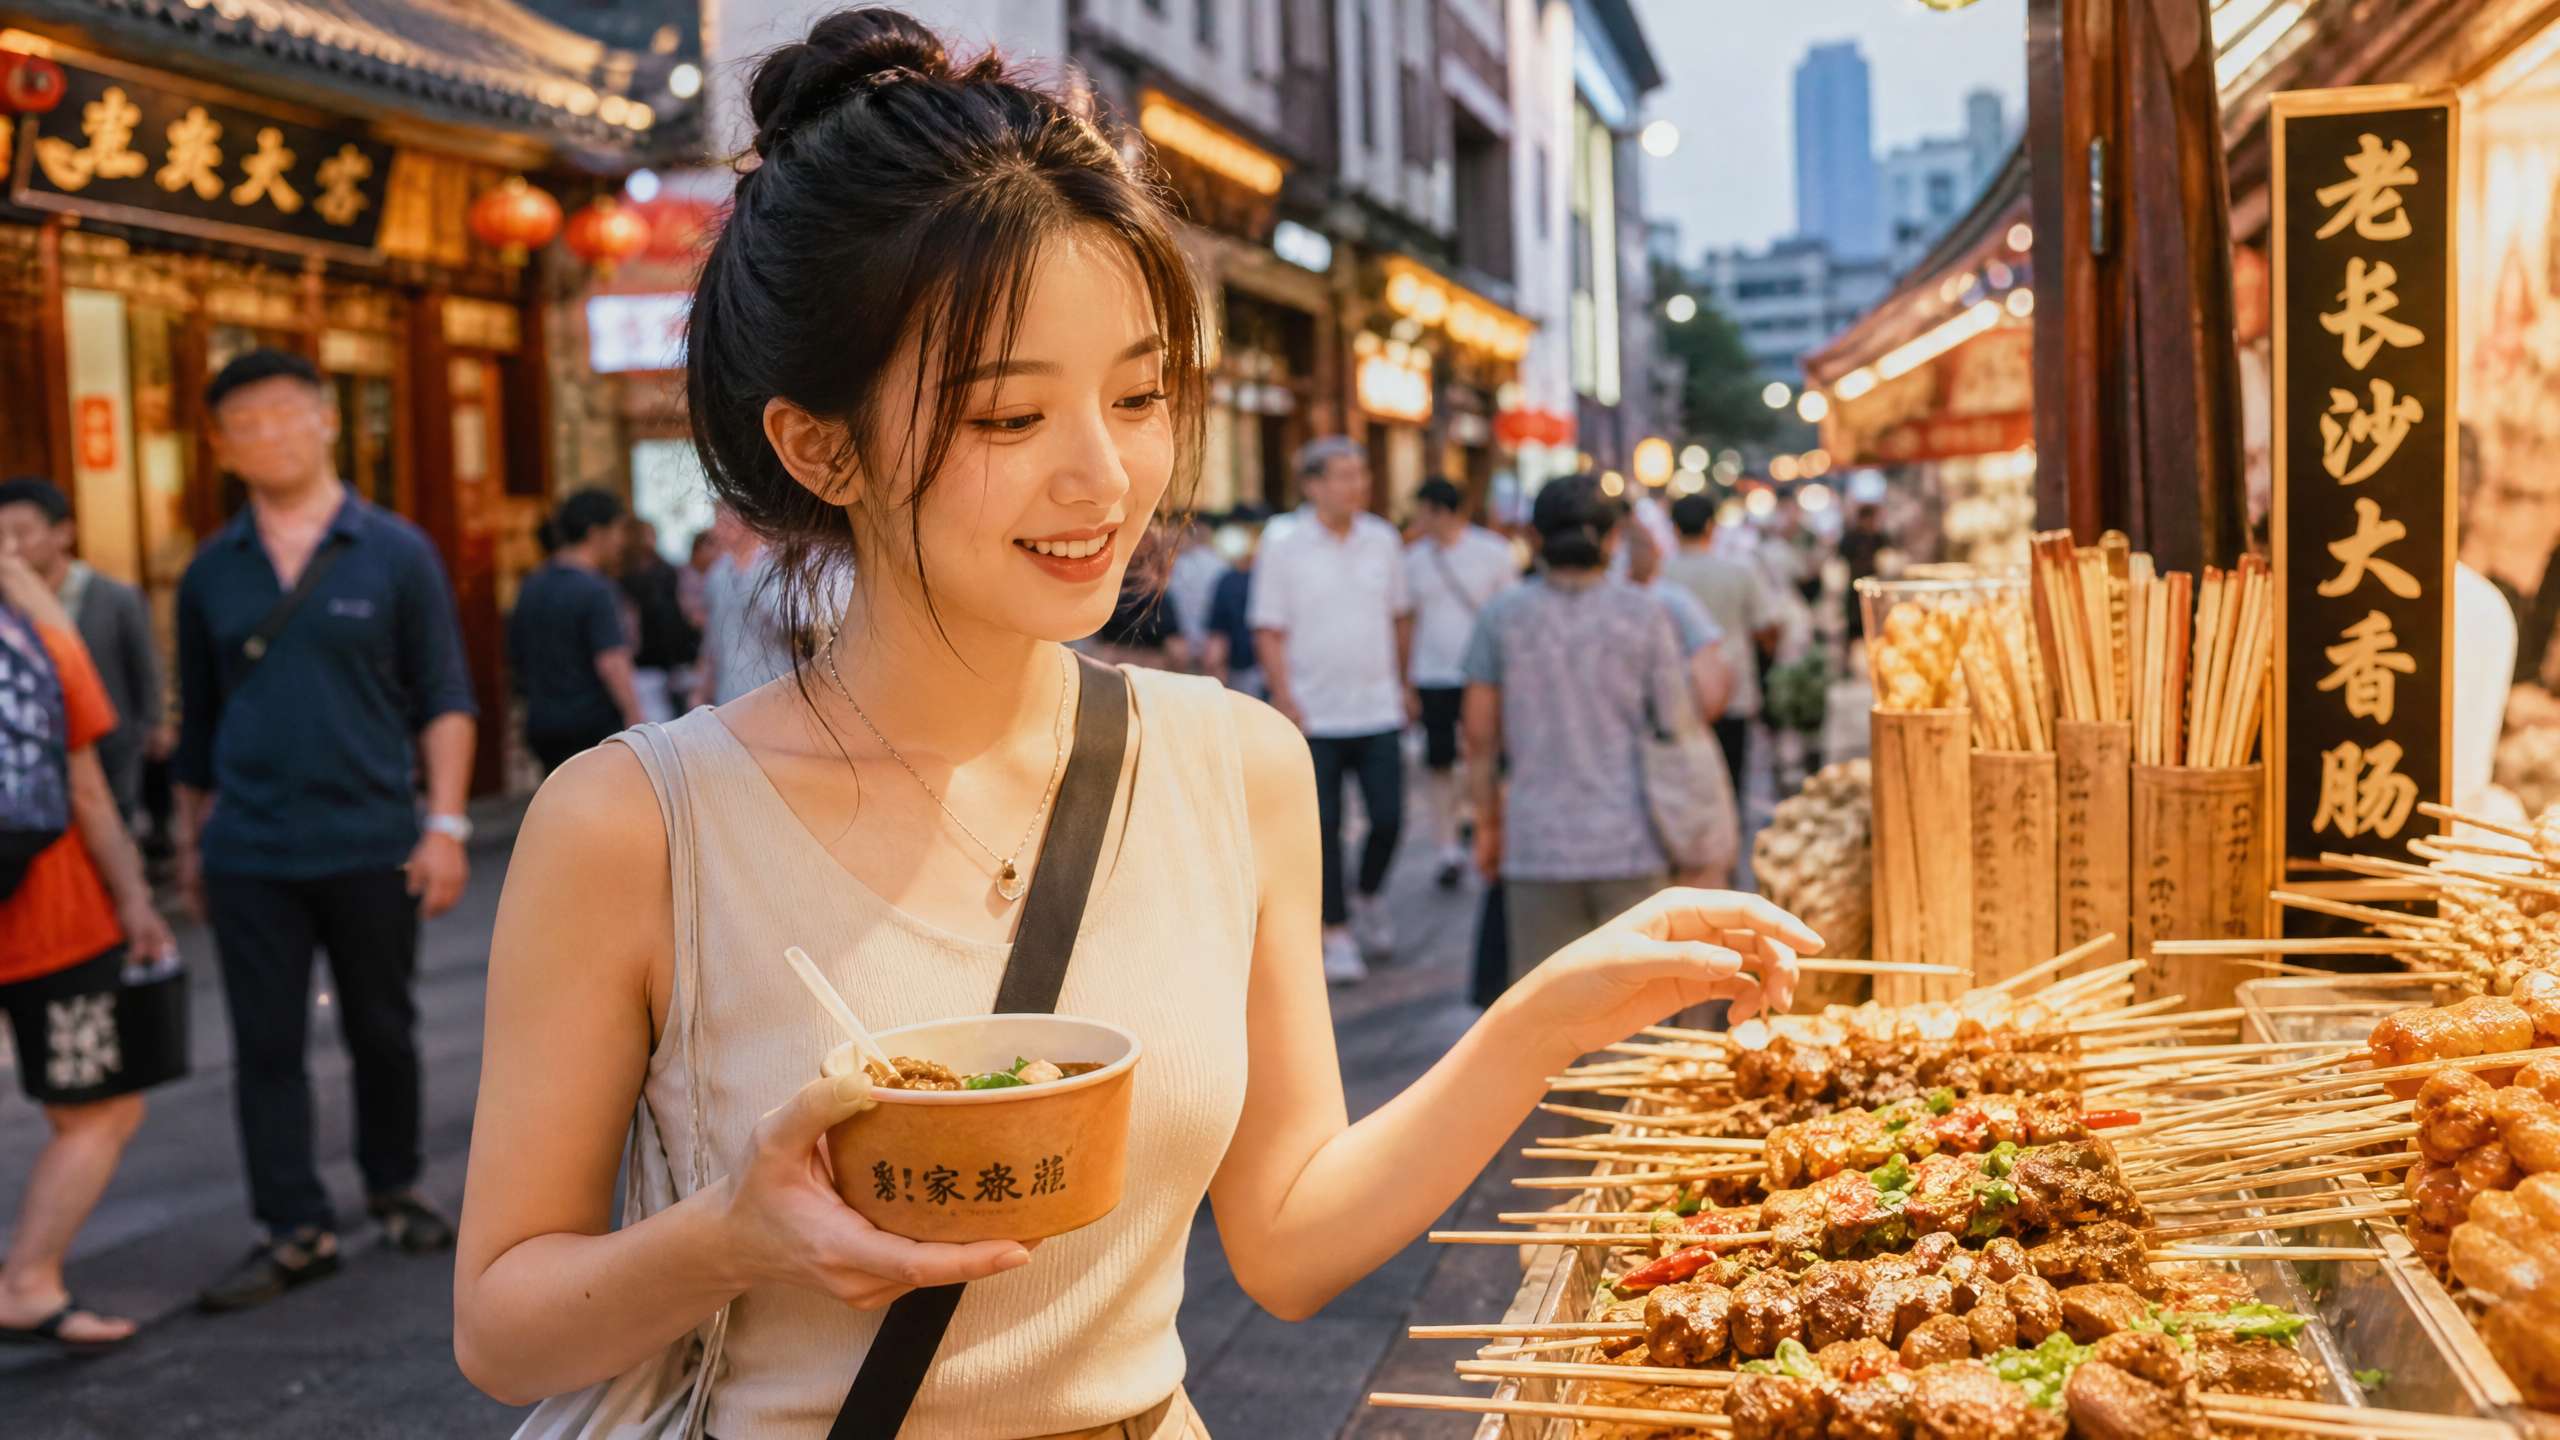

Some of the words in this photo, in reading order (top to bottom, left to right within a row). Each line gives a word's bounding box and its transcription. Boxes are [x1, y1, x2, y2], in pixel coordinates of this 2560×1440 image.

[2312, 133, 2425, 839] 老长沙大香肠
